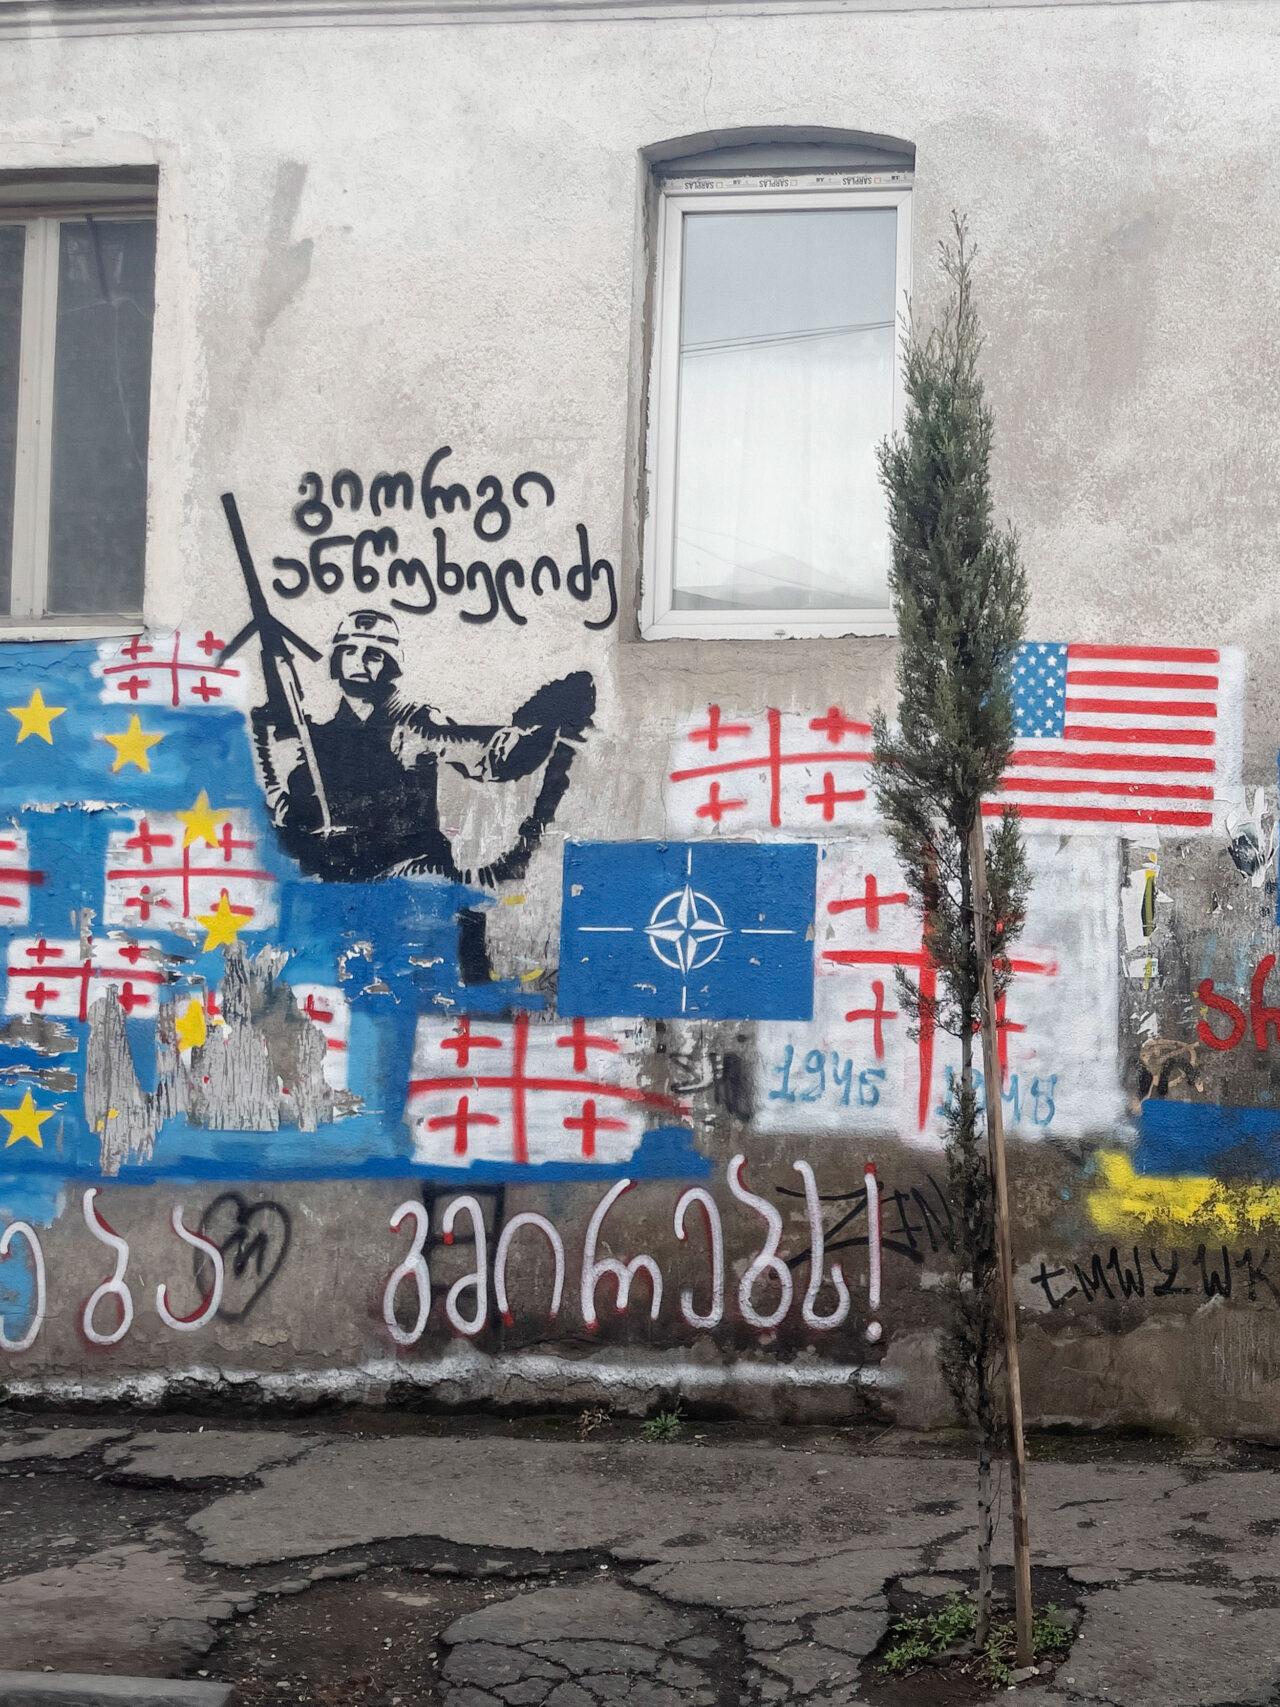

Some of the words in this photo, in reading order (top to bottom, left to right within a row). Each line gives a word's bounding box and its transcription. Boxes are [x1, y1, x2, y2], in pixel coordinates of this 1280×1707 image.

[292, 444, 556, 543] გიორგი
[271, 522, 619, 630] ანწუხელიძე
[382, 1153, 883, 1345] გმირებს!
